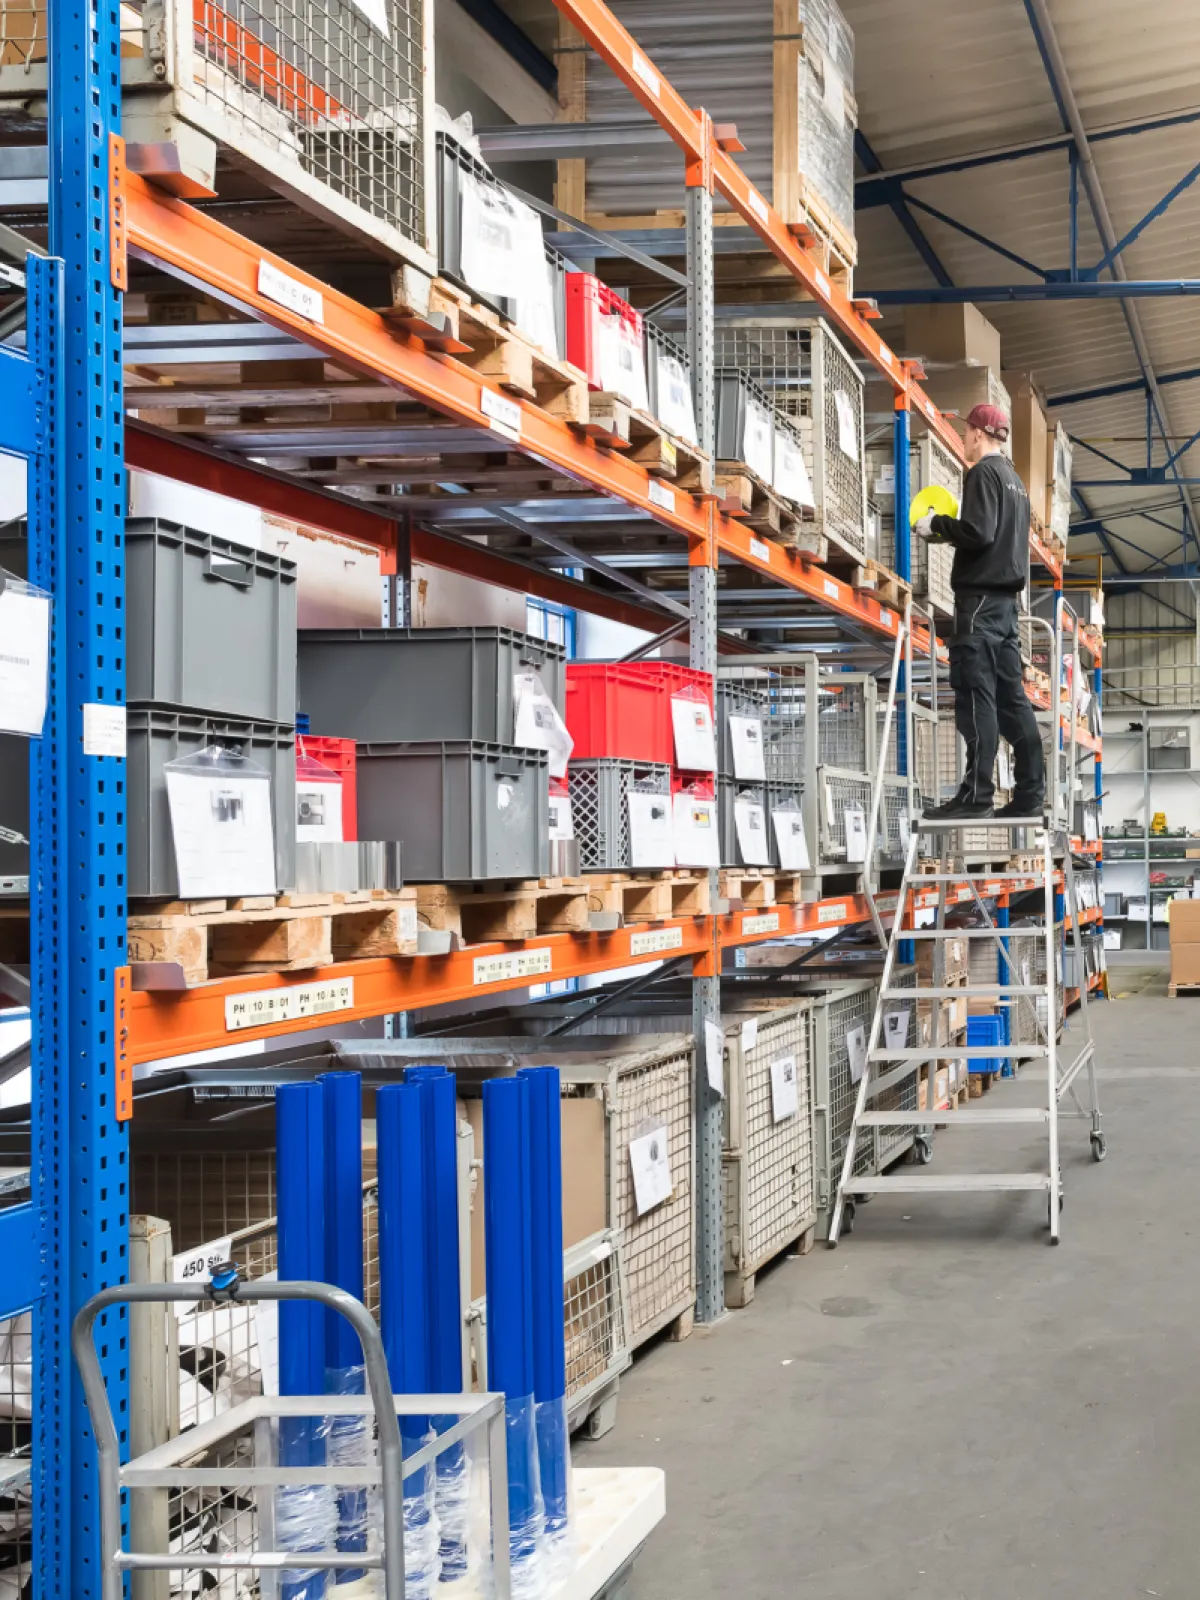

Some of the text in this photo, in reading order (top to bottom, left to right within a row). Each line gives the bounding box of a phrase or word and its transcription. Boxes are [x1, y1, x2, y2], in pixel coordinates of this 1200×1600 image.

[233, 997, 289, 1014] PH 10 B 01
[299, 993, 310, 1004] PH
[316, 990, 325, 1001] 10
[182, 1257, 205, 1278] 450
